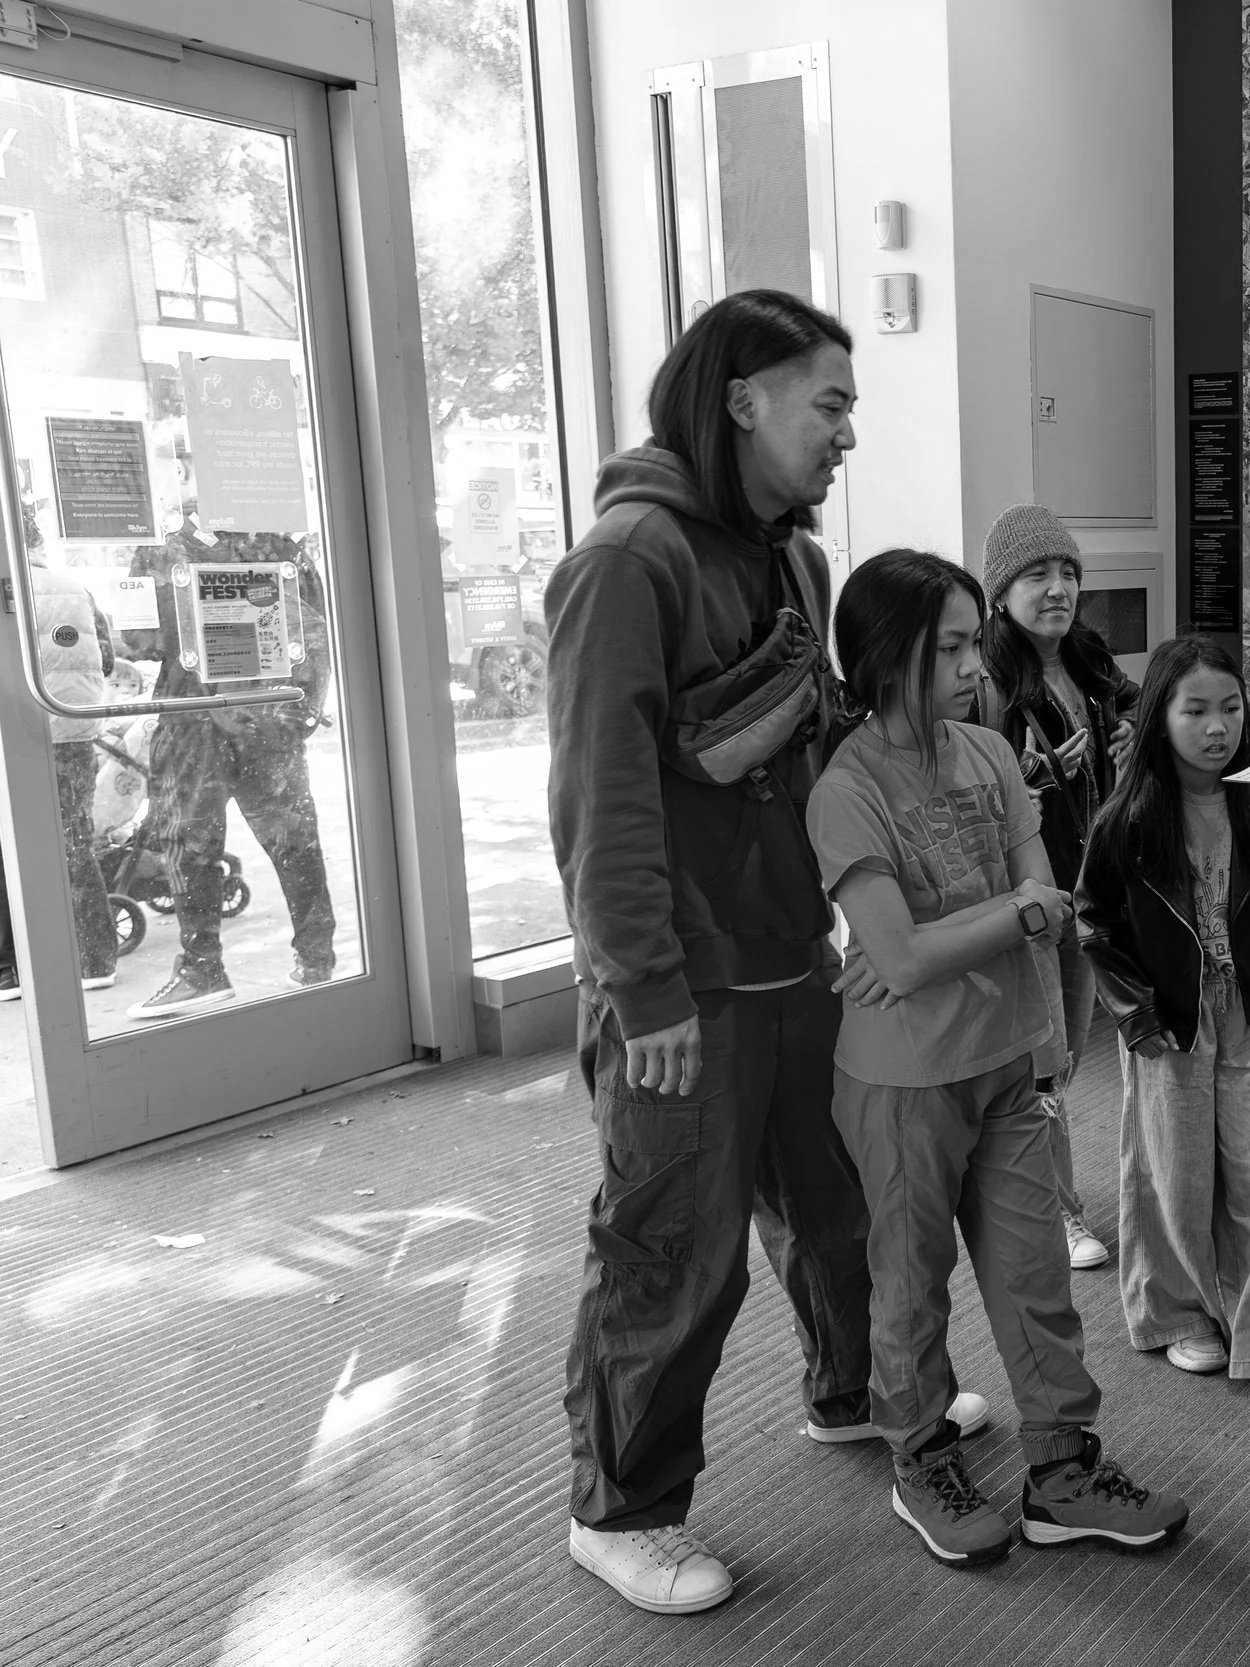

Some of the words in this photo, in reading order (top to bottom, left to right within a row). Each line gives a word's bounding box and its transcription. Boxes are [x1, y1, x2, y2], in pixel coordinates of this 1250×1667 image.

[200, 570, 273, 585] wonder
[200, 585, 248, 600] FEST
[56, 631, 78, 641] PUSH
